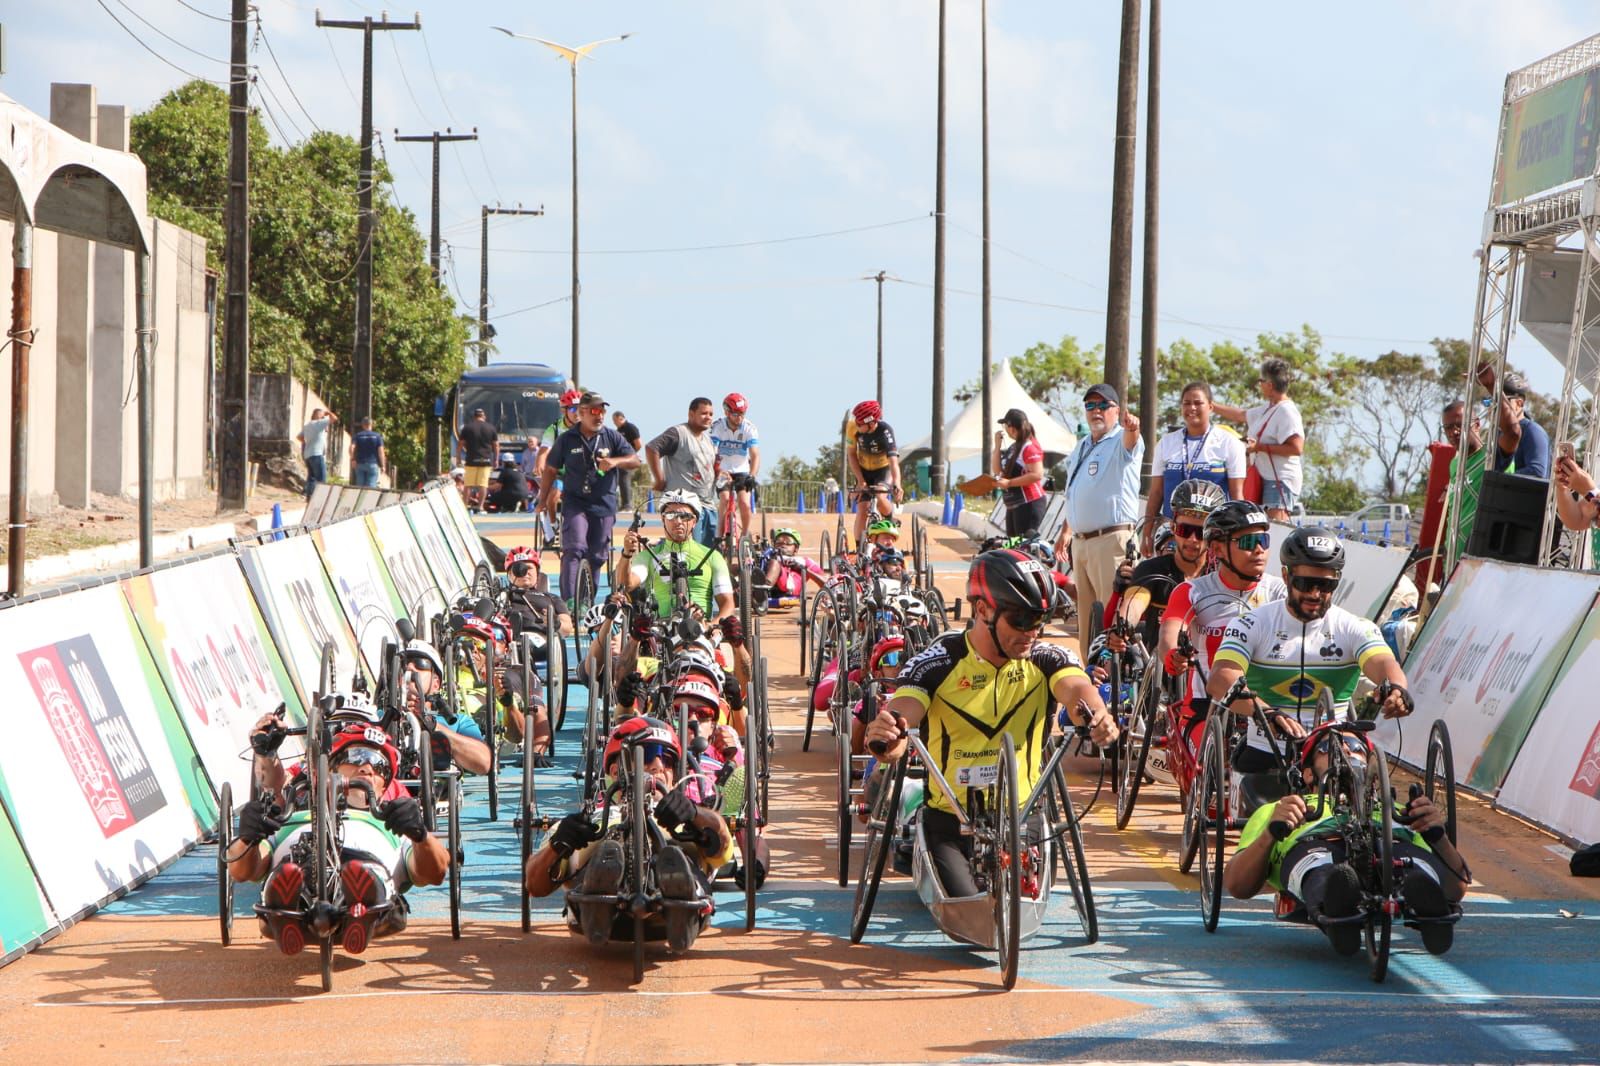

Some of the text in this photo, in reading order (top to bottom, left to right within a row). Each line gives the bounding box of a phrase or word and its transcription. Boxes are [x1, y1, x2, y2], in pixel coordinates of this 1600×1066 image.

[1166, 463, 1210, 471] SEIPE
[1311, 537, 1329, 547] 122
[1491, 637, 1542, 694] nord
